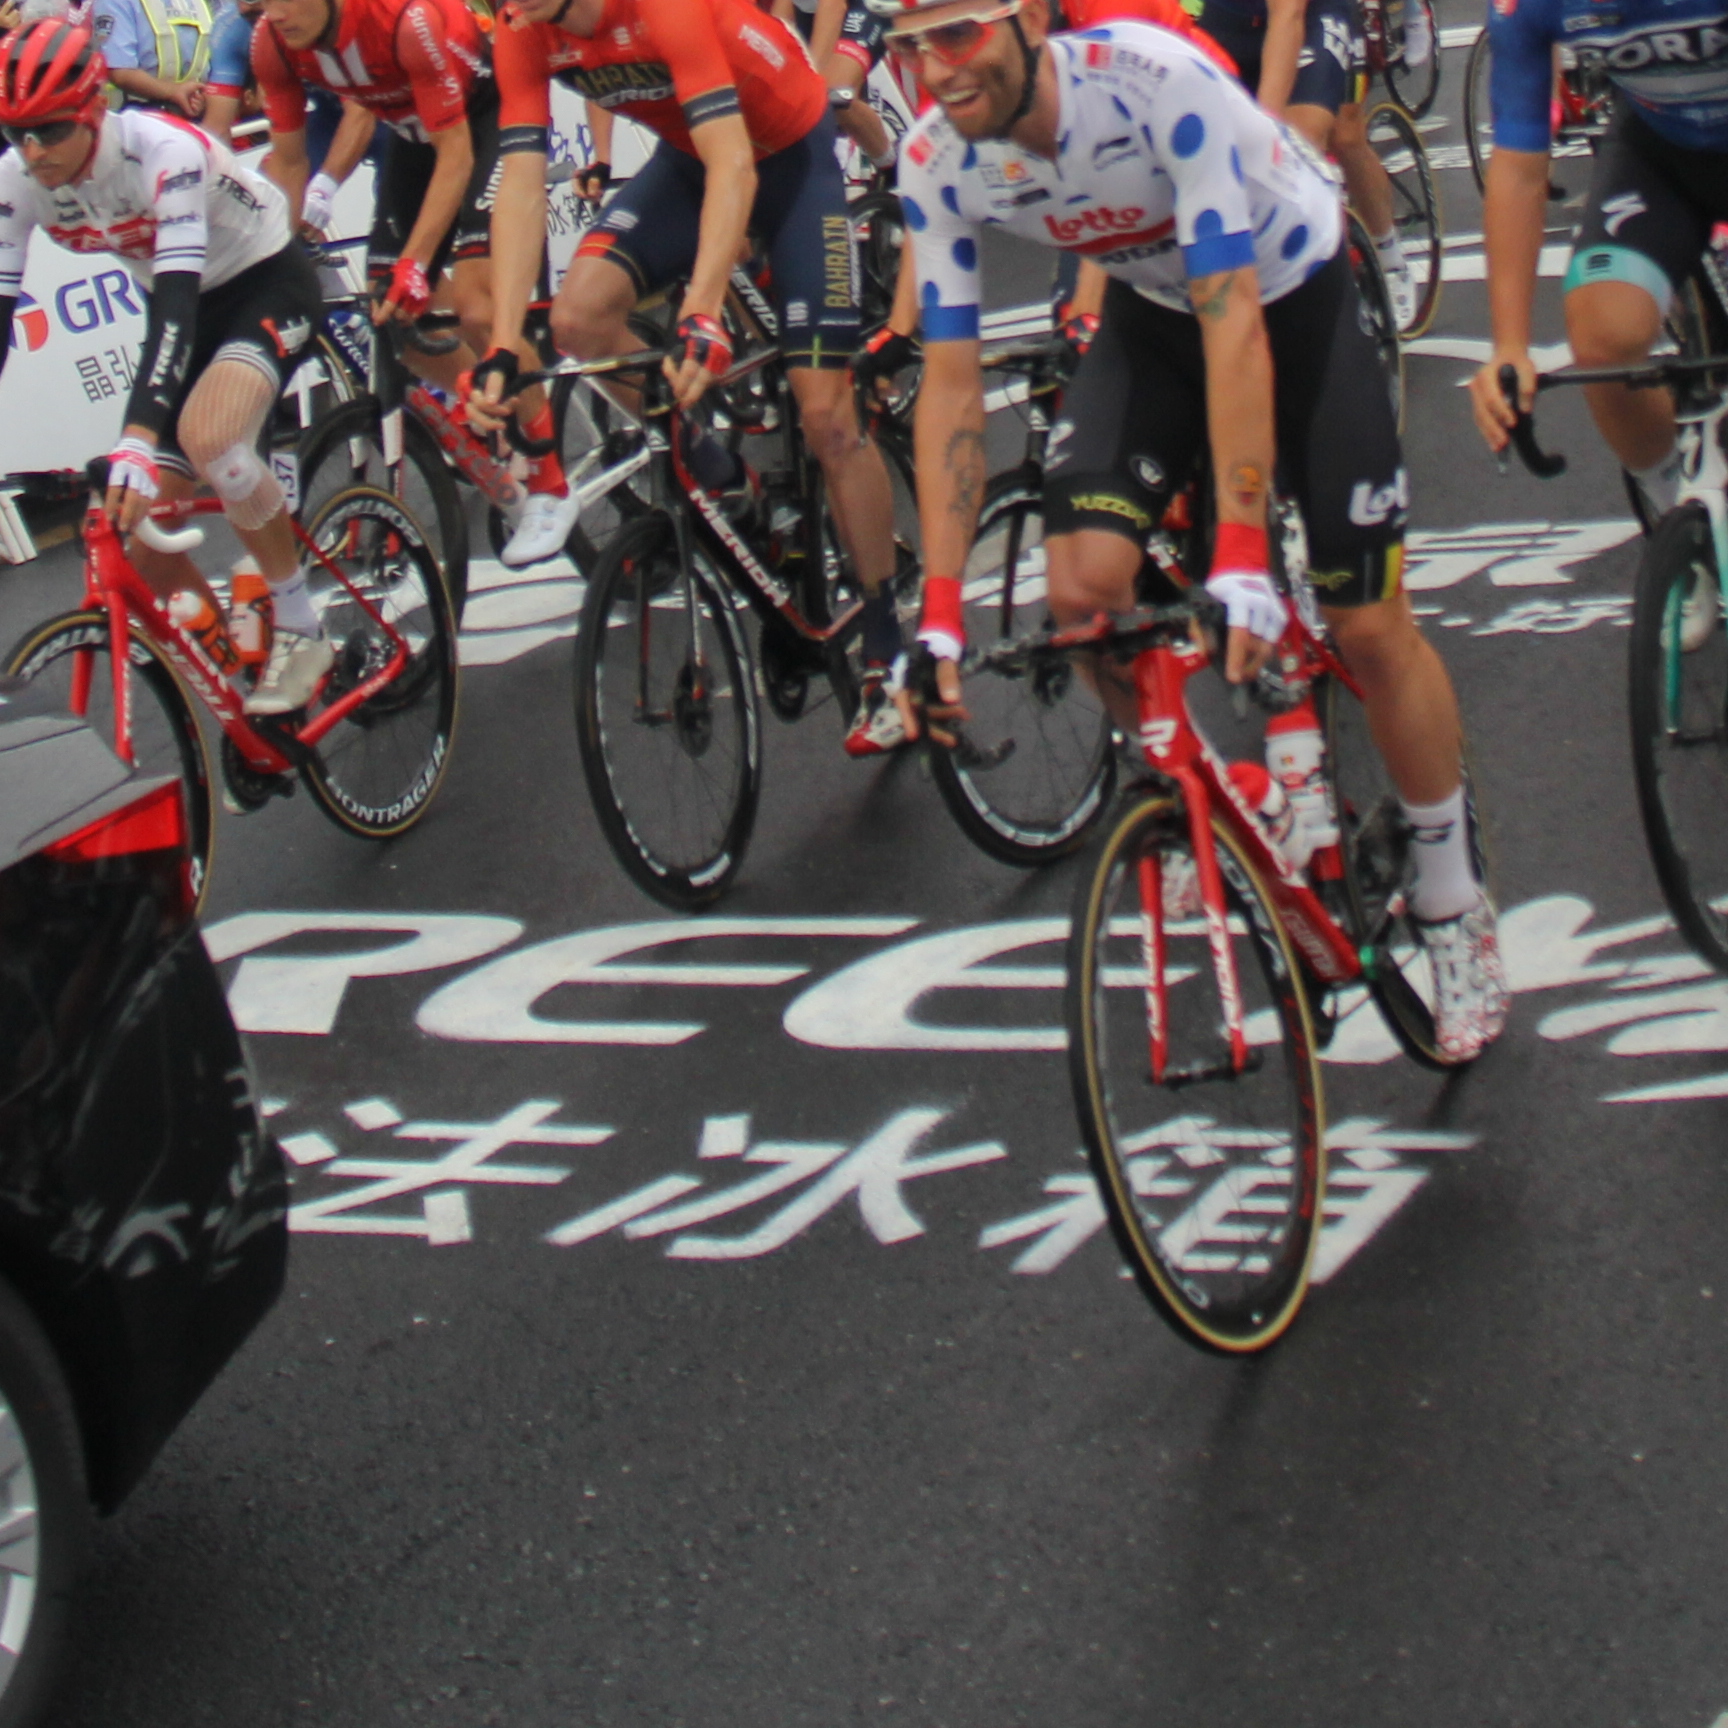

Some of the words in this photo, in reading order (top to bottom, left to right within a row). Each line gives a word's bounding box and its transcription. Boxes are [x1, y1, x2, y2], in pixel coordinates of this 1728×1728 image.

[217, 173, 268, 214] TREK
[55, 268, 145, 334] GR
[822, 215, 849, 310] BAHRAIN
[200, 911, 1249, 1051] REE
